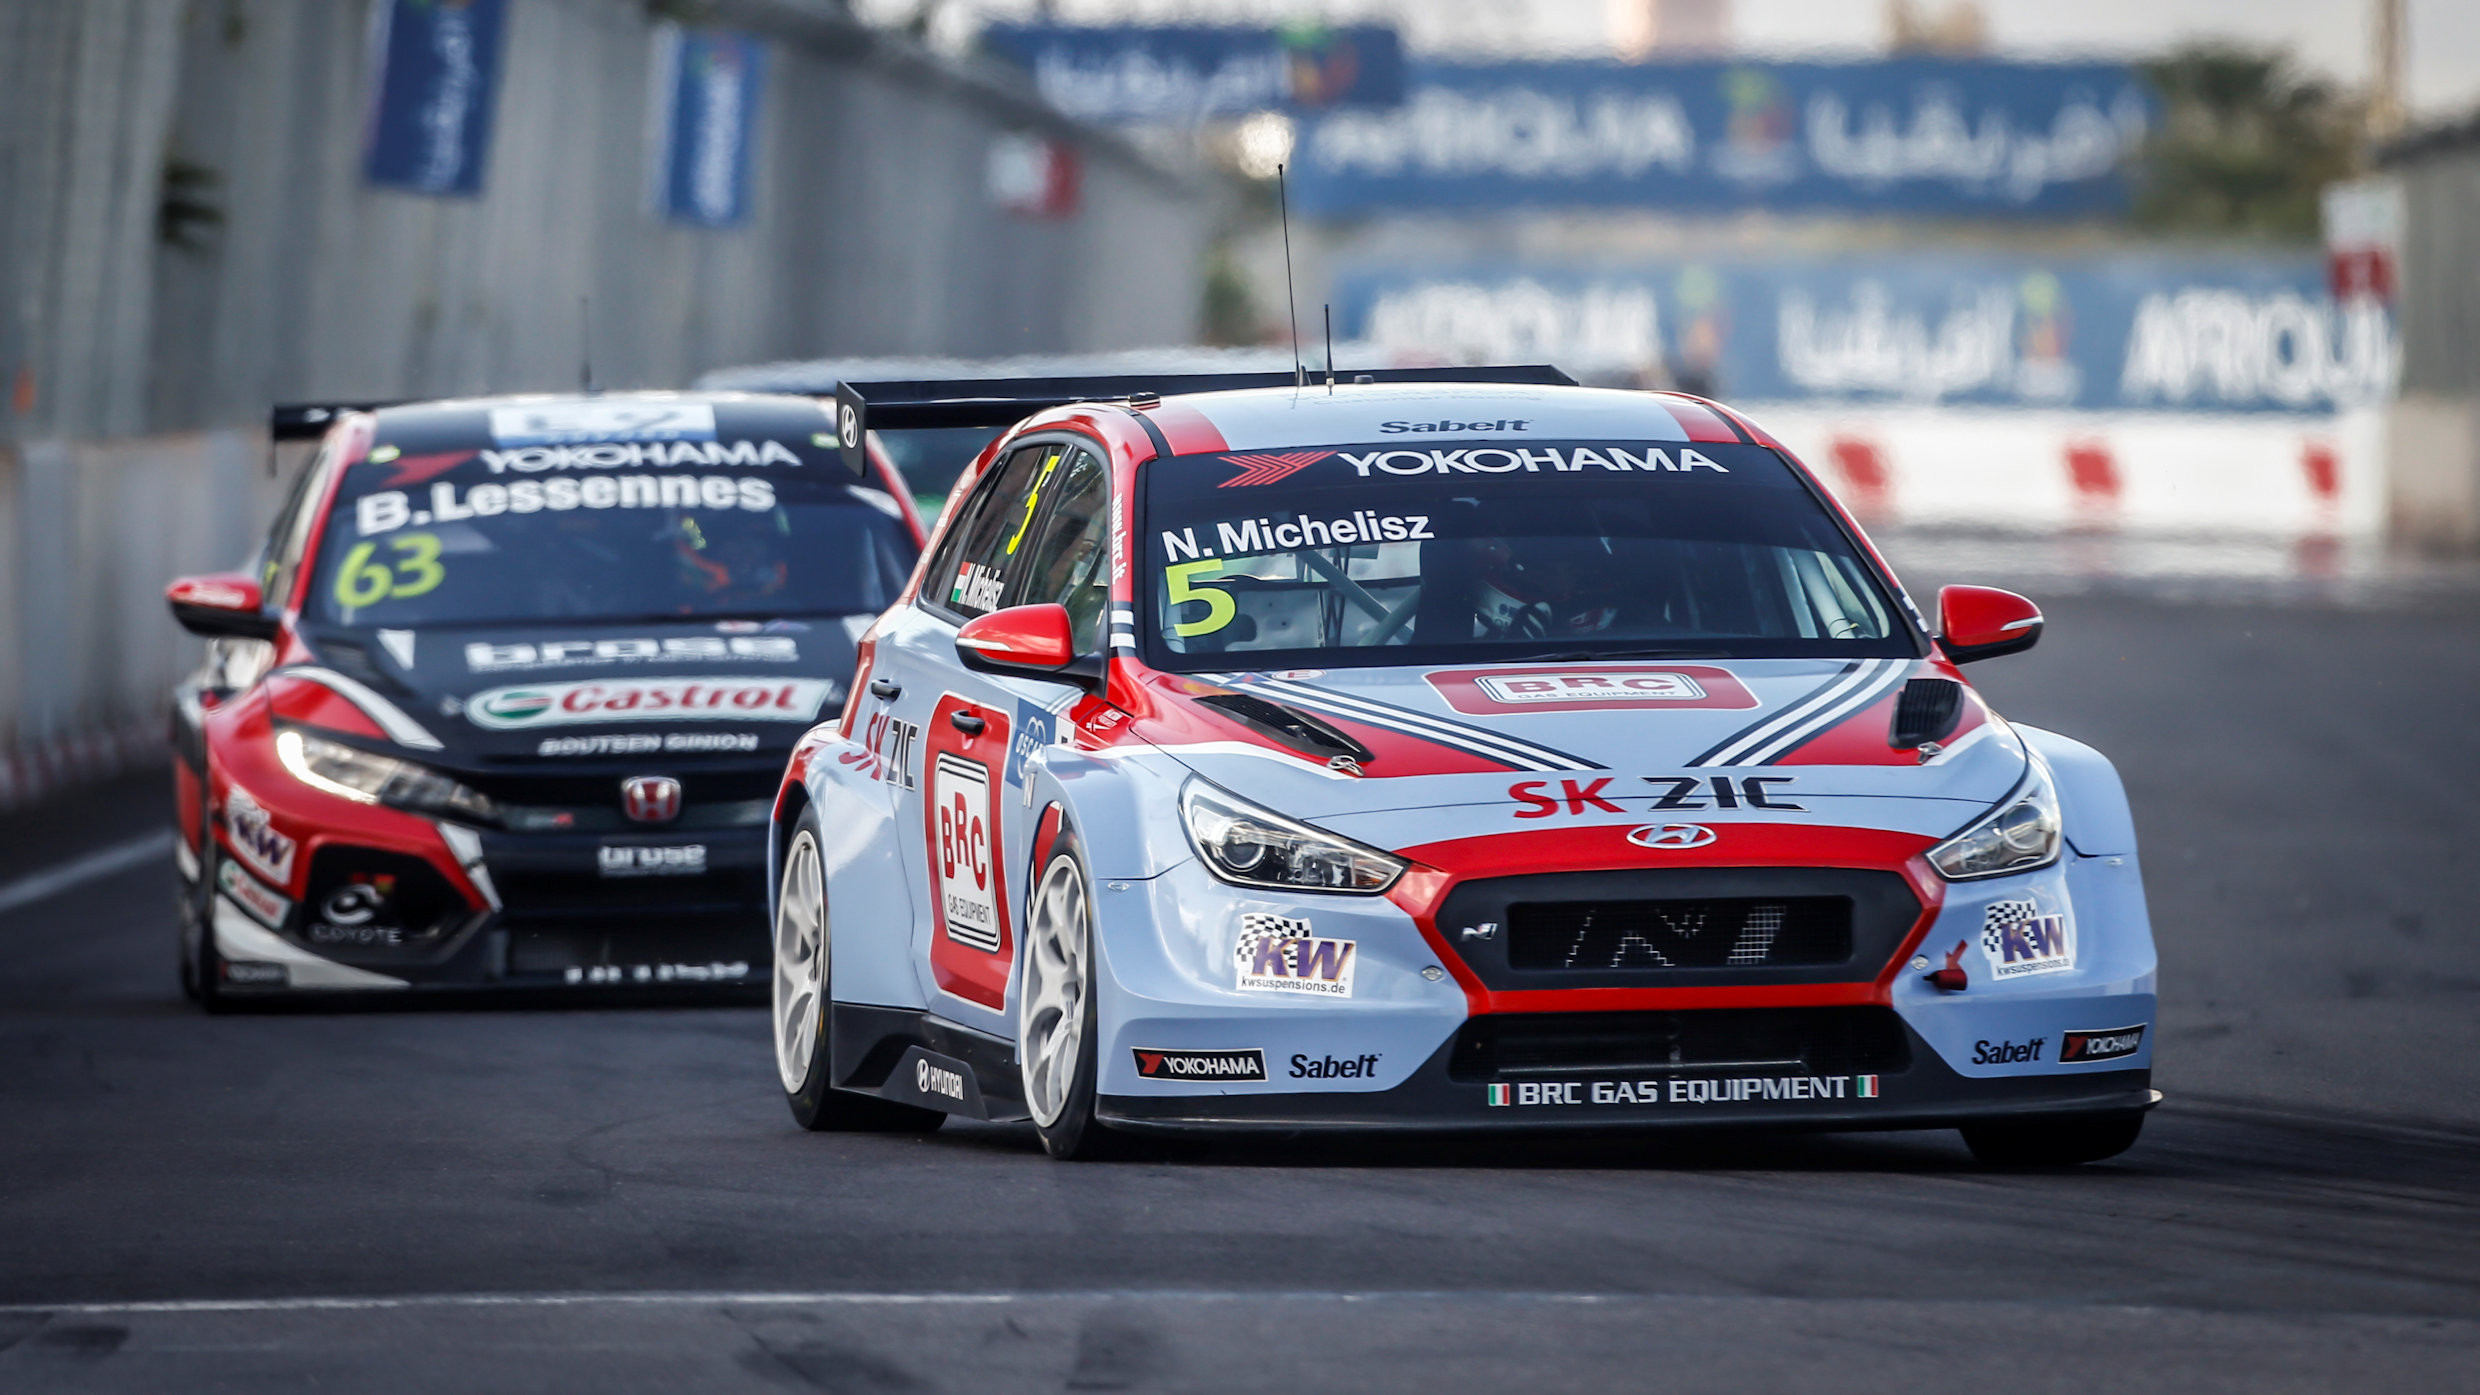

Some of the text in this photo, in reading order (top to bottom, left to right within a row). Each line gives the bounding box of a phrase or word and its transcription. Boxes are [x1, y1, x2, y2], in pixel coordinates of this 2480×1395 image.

[1379, 419, 1531, 434] Sabelt
[480, 440, 803, 474] YOKOHAMA
[1337, 447, 1730, 477] YOKOHAMA
[1161, 510, 1436, 563] N. Michelisz
[334, 532, 446, 609] 63
[1165, 558, 1237, 638] 5
[561, 680, 800, 715] Castrol
[1503, 677, 1676, 694] BRC
[1566, 690, 1678, 698] EQUIPMENT
[1508, 774, 1812, 819] SK ZIC
[940, 791, 987, 892] BRC
[2000, 917, 2065, 965] KW
[1250, 935, 1356, 983] KW
[1241, 975, 1346, 994] kwsuspensions.de
[1163, 1056, 1261, 1075] YOKOHAMA
[1288, 1053, 1380, 1080] Sabelt
[1972, 1037, 2047, 1066] Sabelt
[929, 1065, 964, 1101] HYUNDAI
[1518, 1075, 1851, 1105] BRC GAS EQUIPMENT
